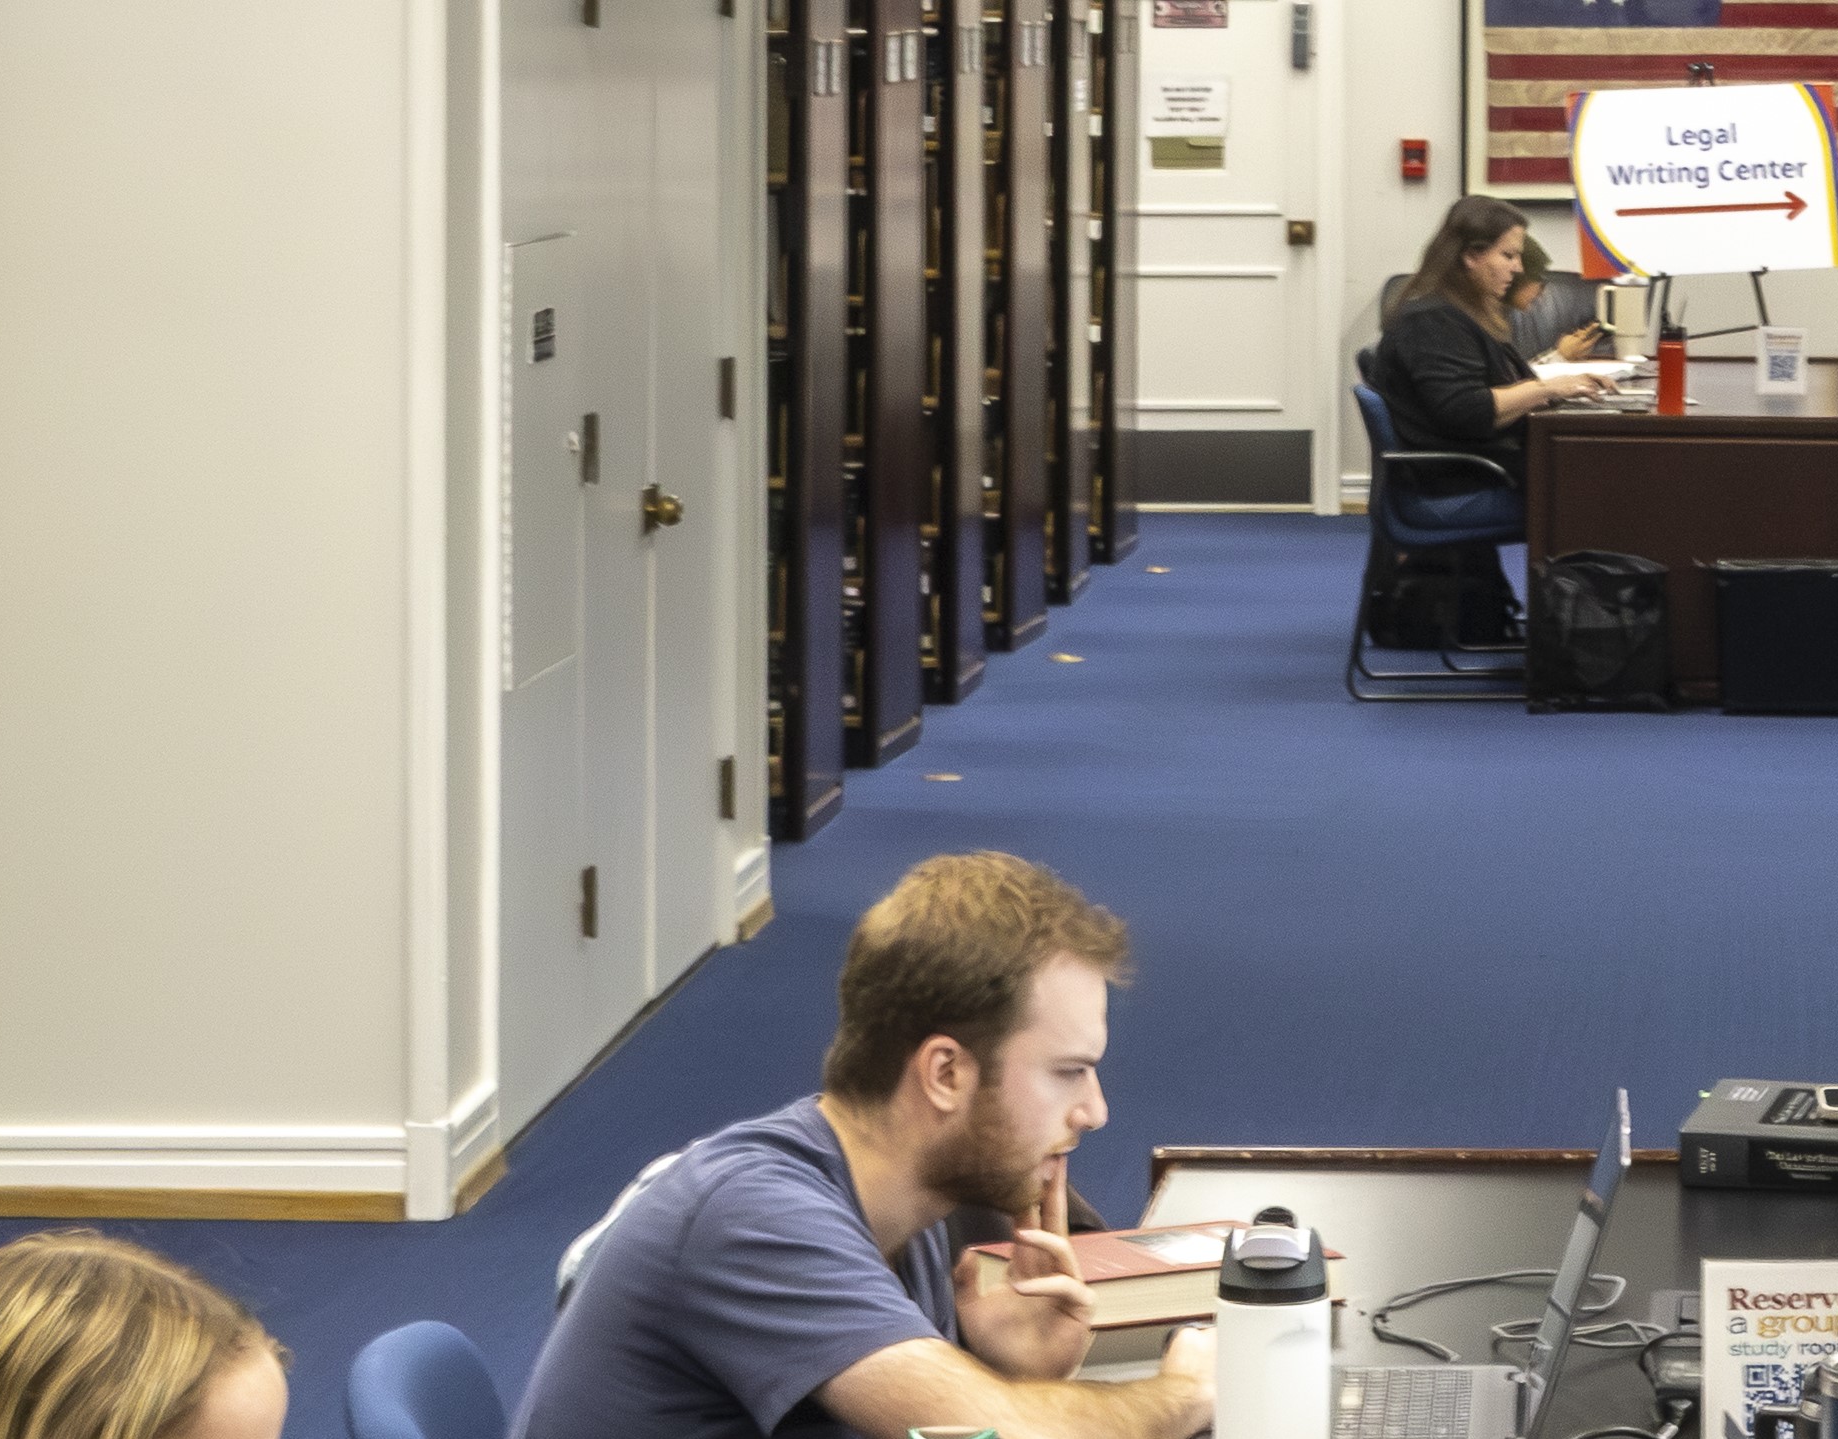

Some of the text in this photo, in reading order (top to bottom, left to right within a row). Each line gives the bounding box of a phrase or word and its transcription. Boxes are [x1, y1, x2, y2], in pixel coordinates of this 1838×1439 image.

[1666, 123, 1738, 151] Legal
[1607, 160, 1808, 188] Writing Center
[1727, 1316, 1748, 1334] a
[1728, 1341, 1792, 1358] study
